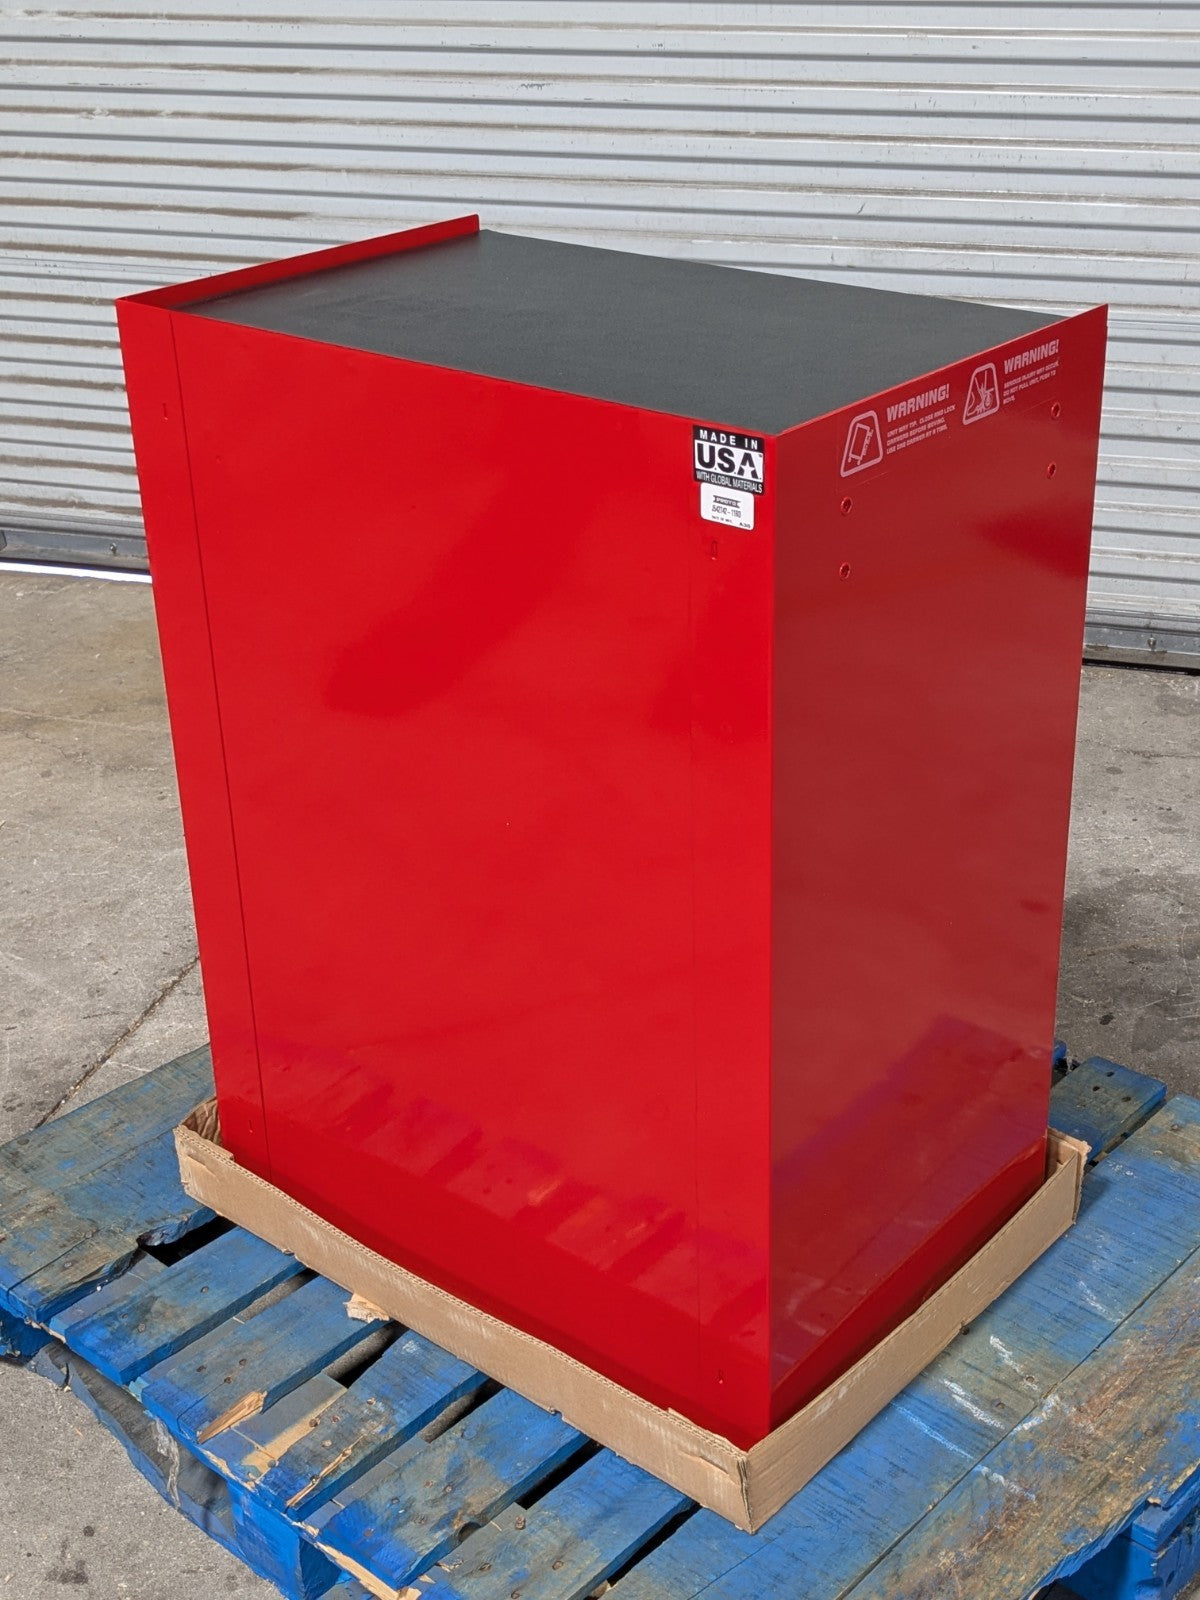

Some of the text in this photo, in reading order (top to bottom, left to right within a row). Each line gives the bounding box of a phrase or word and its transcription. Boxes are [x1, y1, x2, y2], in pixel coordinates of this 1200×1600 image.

[1004, 339, 1059, 374] WARNING!
[886, 383, 949, 422] WARNING!
[943, 404, 955, 413] LOCK
[699, 429, 758, 450] MADE IN
[696, 470, 763, 494] WITH GLOBAL MATERIALS
